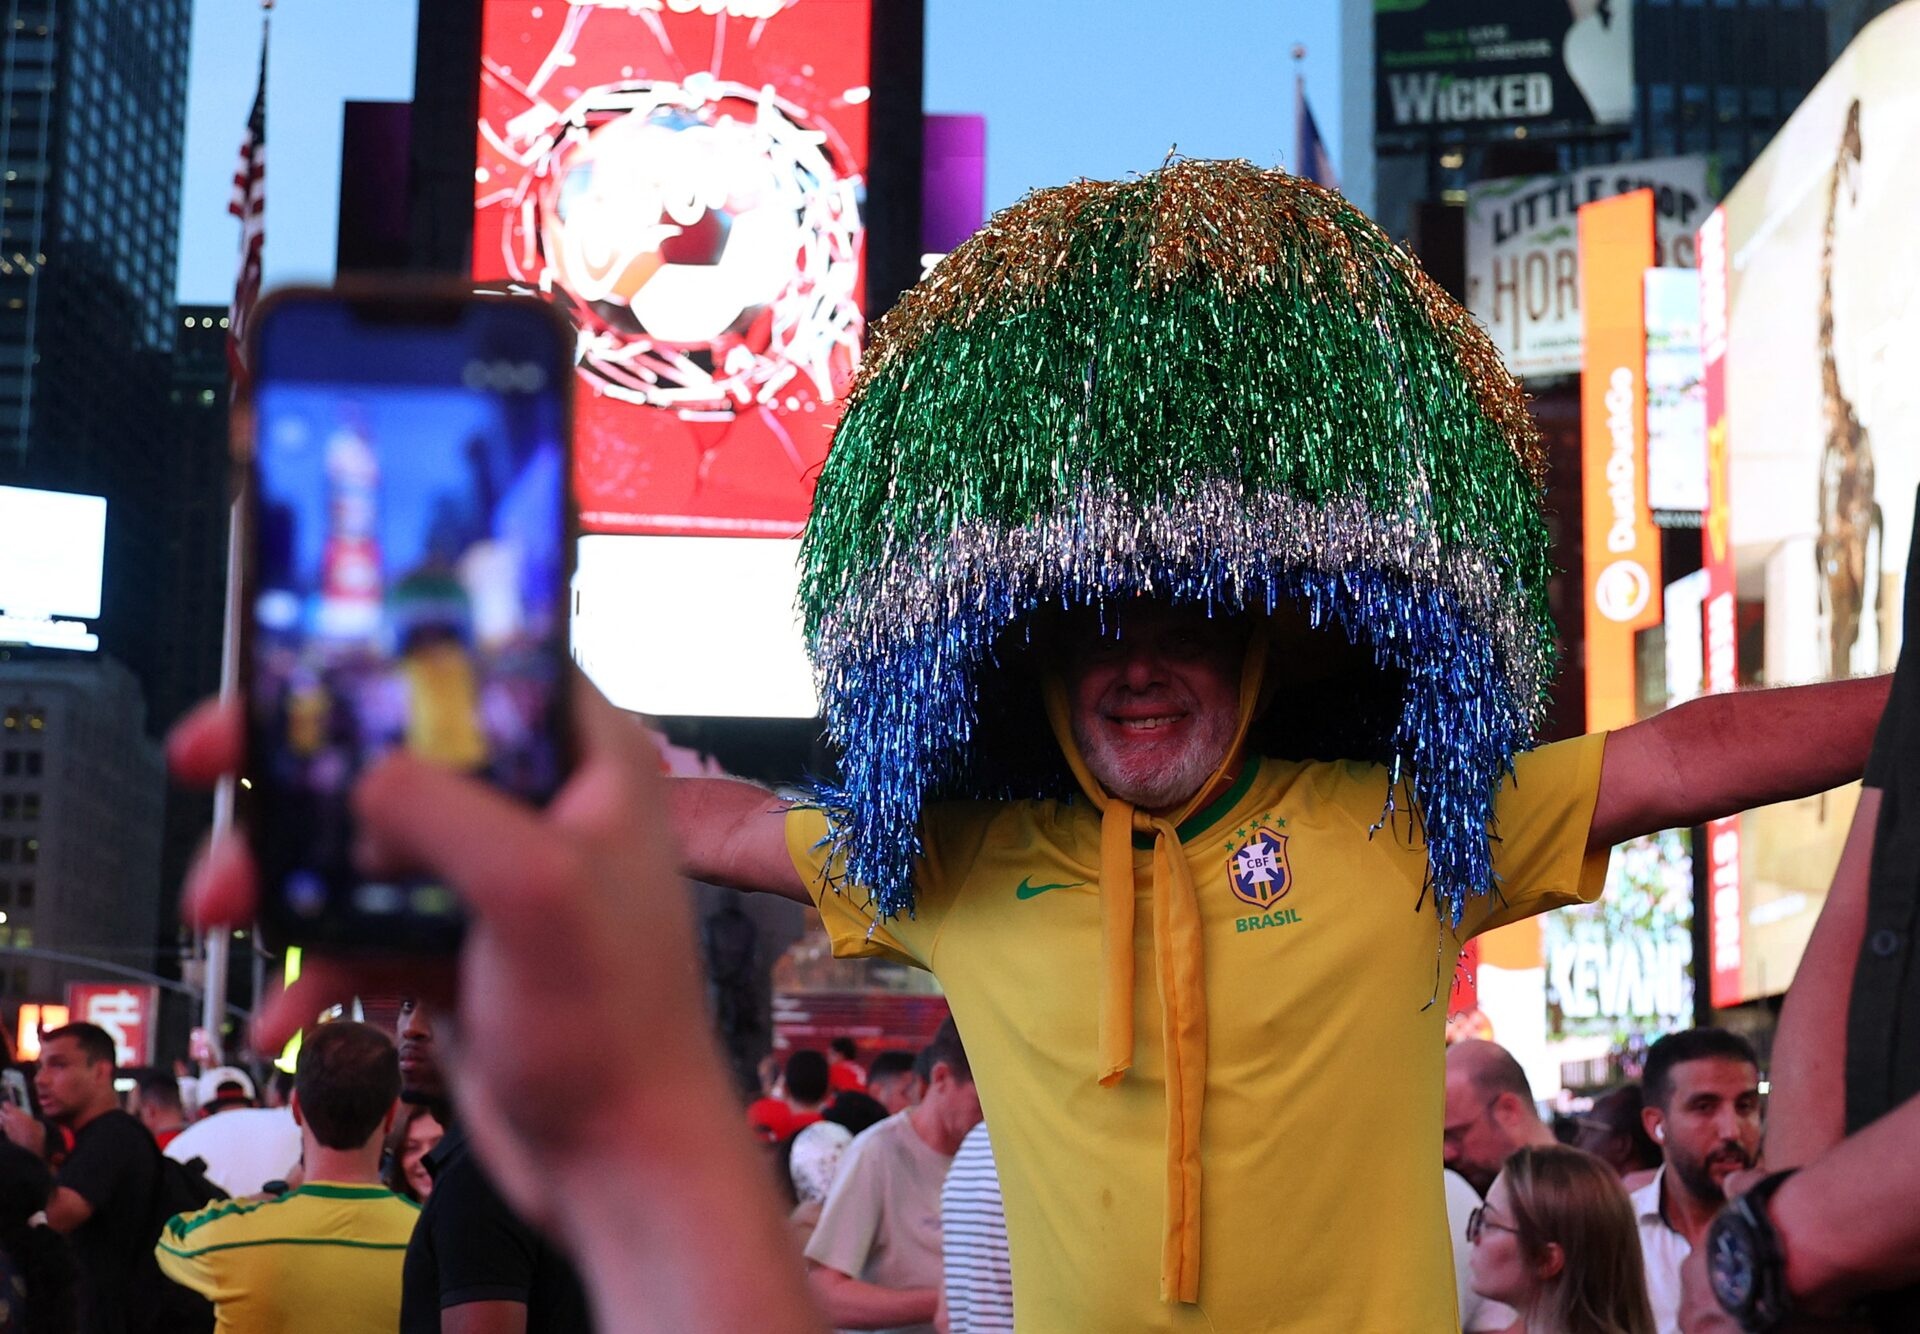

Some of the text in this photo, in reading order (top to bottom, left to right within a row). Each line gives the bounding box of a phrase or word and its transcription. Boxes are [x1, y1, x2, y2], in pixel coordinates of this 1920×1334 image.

[1389, 71, 1553, 125] WICKED
[1247, 857, 1269, 869] CBF
[1236, 909, 1302, 933] BRASIL
[1713, 830, 1742, 973] STORE
